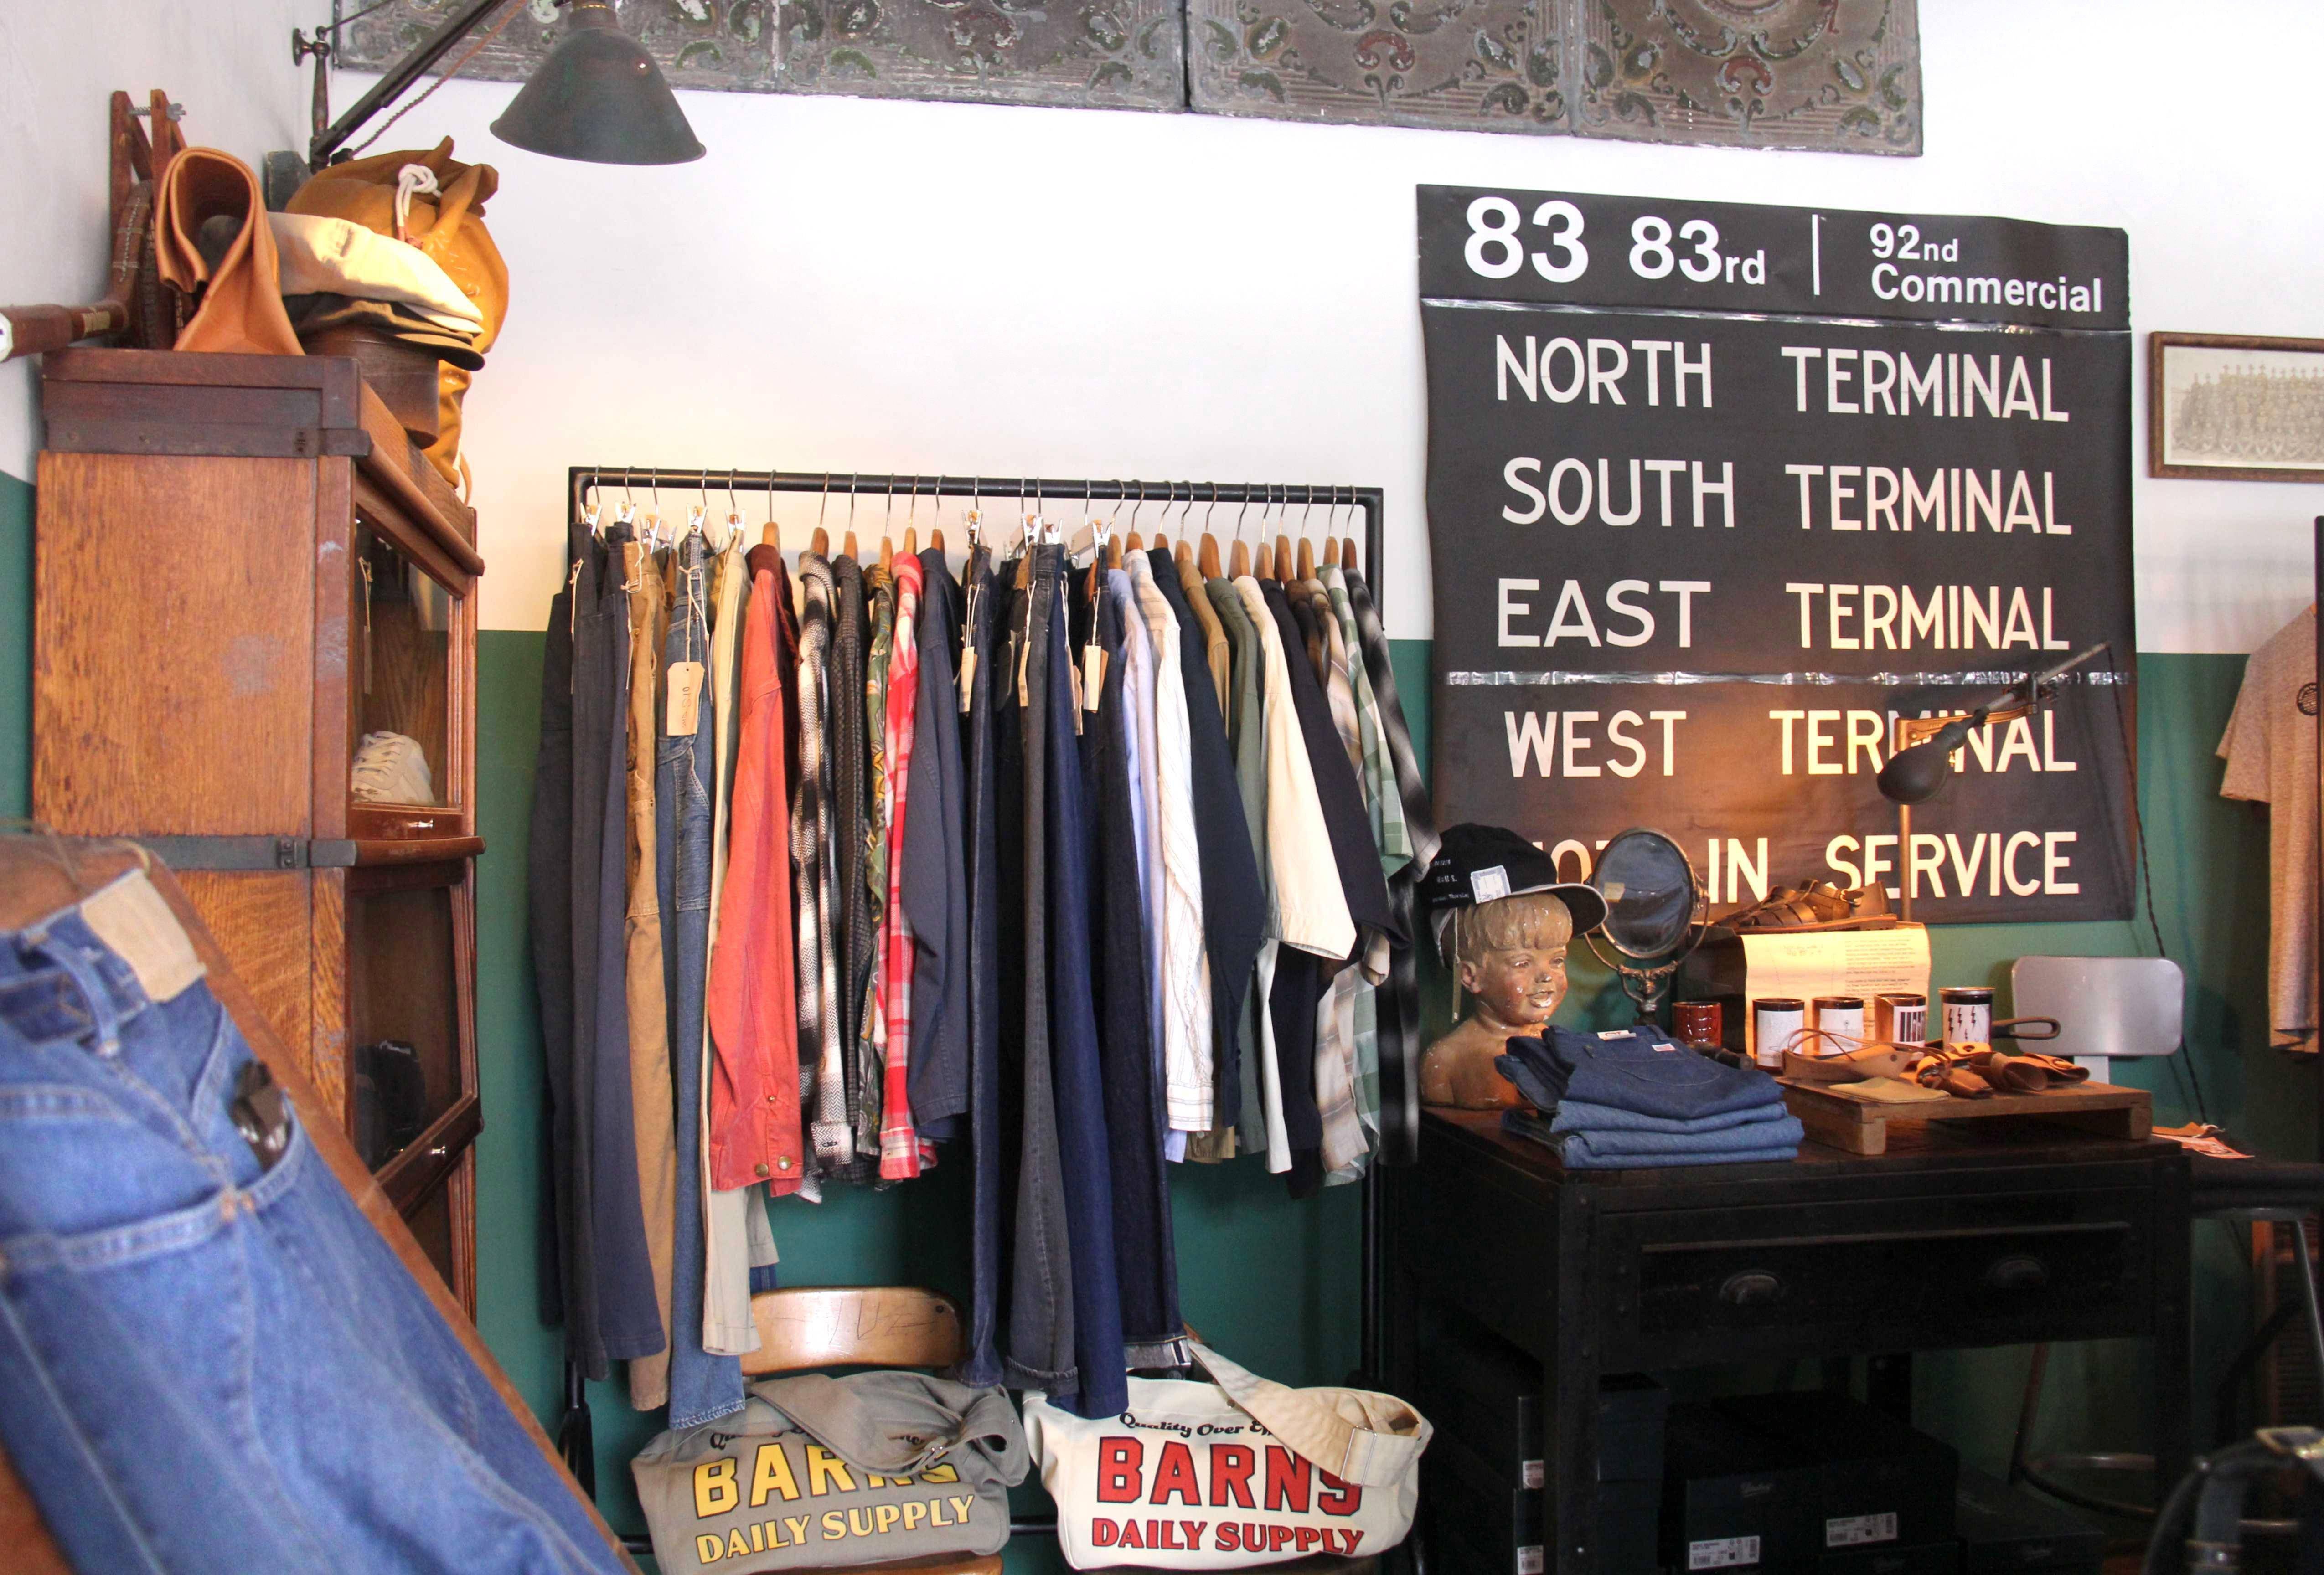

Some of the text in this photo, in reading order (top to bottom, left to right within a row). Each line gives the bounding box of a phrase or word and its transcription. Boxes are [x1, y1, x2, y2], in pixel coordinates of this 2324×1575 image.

[1464, 196, 1766, 285] 83 83rd
[1869, 223, 1958, 262] 92nd
[1871, 262, 2102, 312] Commercial
[1496, 334, 2069, 422] NORTH TERMINAL
[1502, 457, 2072, 535] SOUTH TERMINAL
[1498, 578, 2070, 650] EAST TERMINAL
[1504, 710, 2077, 779] WEST TERNAL
[1708, 830, 2080, 904] IN SERVICE
[1119, 1412, 1192, 1438] Quality
[1197, 1423, 1244, 1436] Over
[693, 1442, 960, 1519] BAR
[1097, 1436, 1363, 1516] BARNS
[696, 1494, 974, 1564] DAILY SUPPLY
[1092, 1518, 1364, 1554] DAILY SUPPLY
